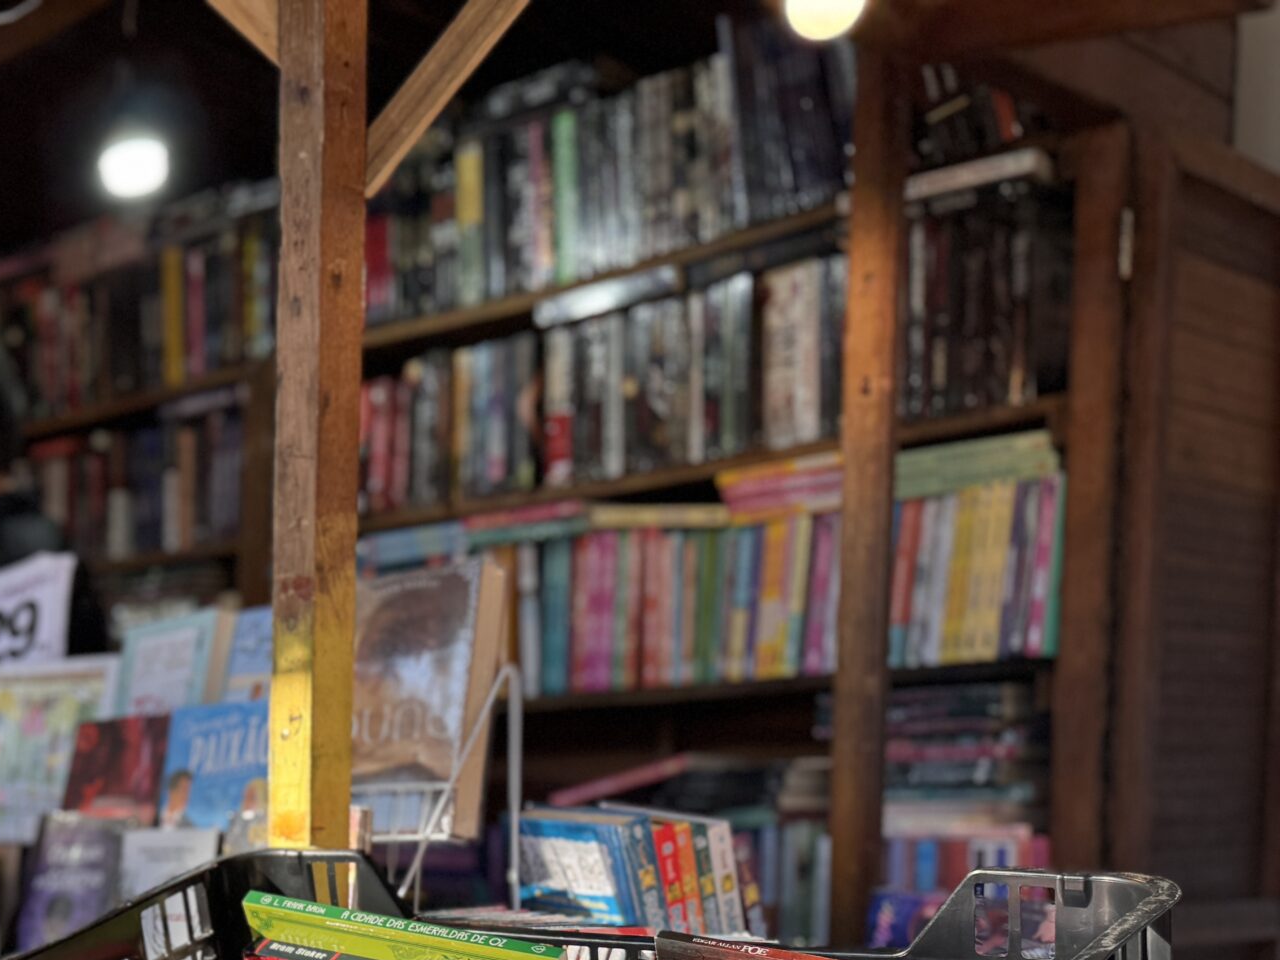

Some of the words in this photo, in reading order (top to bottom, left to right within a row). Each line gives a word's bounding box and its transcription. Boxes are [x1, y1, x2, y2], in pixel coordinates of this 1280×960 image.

[283, 901, 306, 912] FRANK
[307, 904, 326, 915] BAUM
[341, 910, 349, 920] A
[350, 911, 385, 927] CIDADE
[386, 918, 406, 930] DAS
[408, 921, 469, 941] ESMERALDAS
[470, 933, 487, 943] DE
[489, 938, 507, 947] OZ
[294, 947, 328, 960] Stoker
[741, 944, 769, 956] POE
